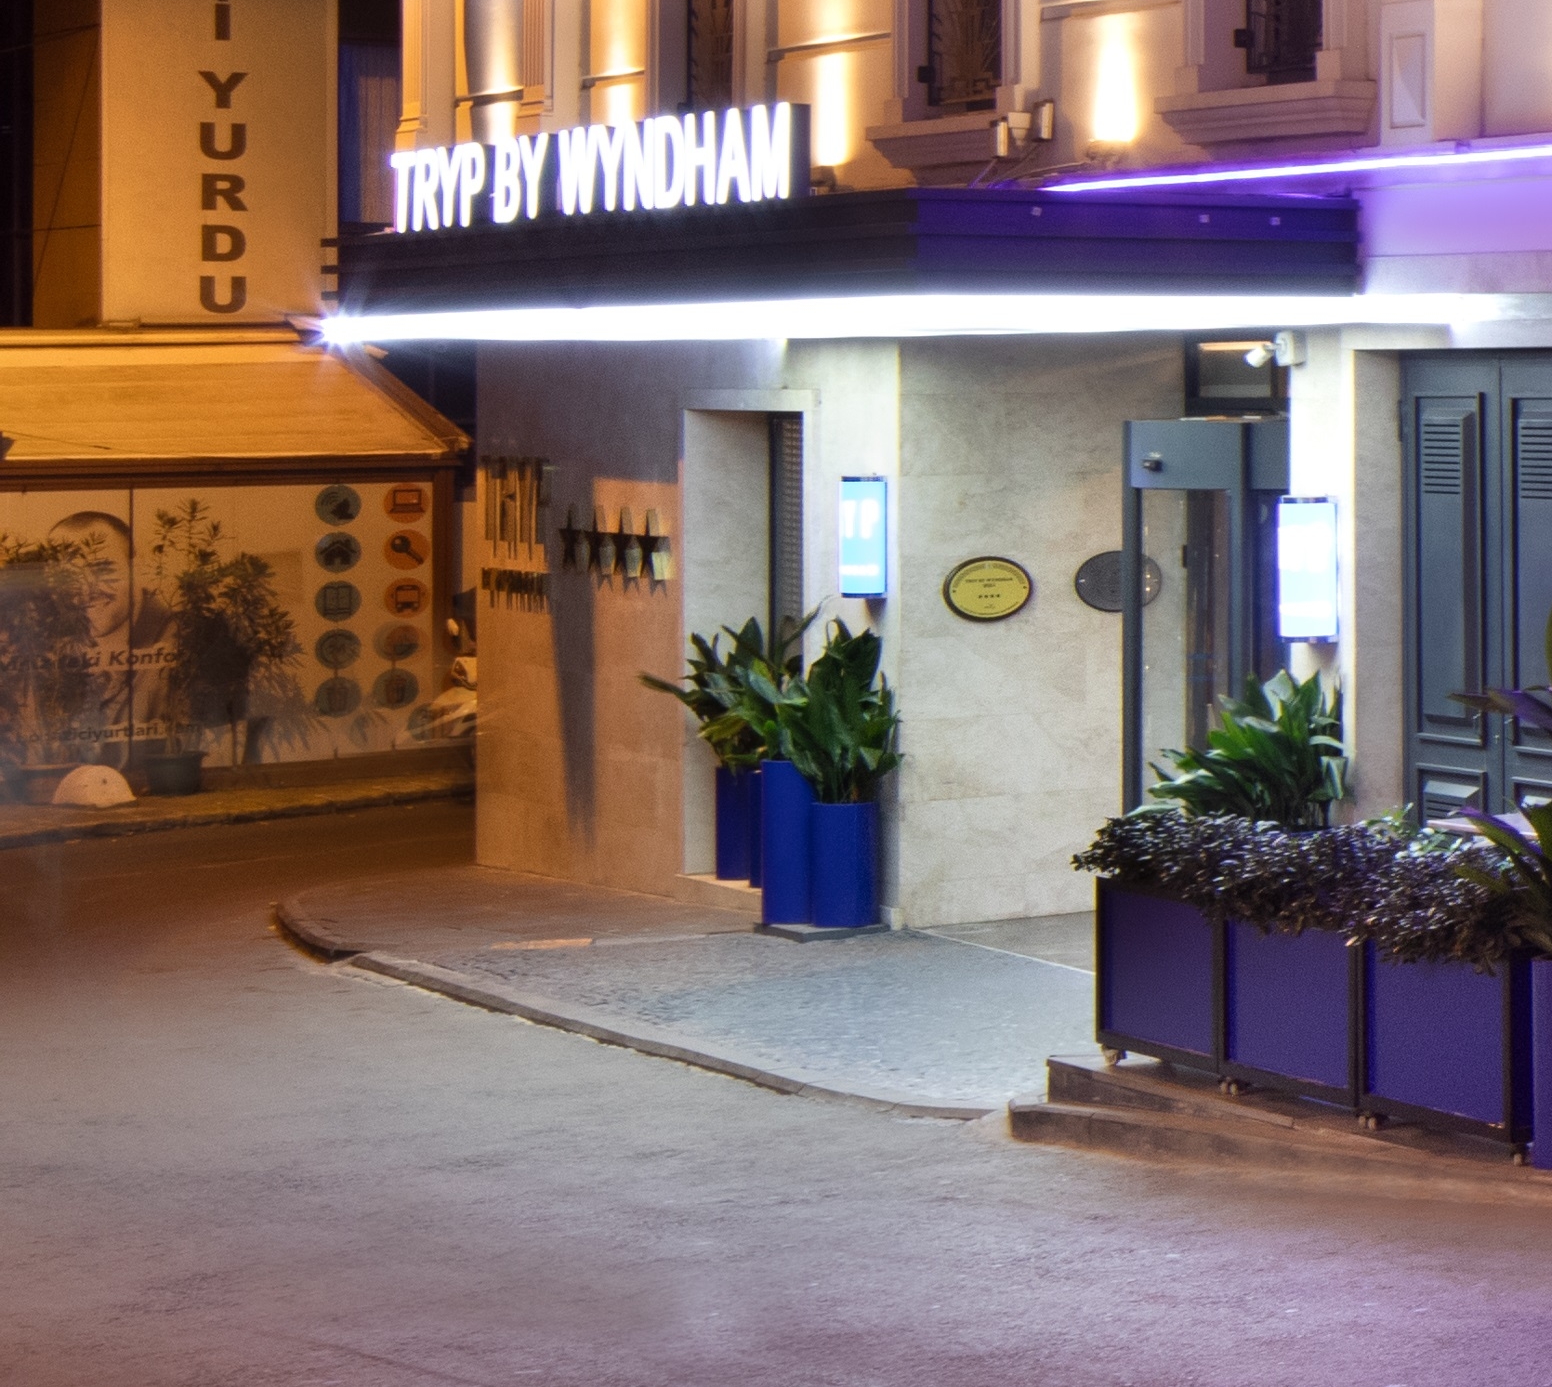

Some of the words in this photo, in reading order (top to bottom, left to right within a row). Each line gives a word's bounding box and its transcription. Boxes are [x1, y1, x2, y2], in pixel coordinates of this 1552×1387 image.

[198, 70, 249, 314] YURDU
[391, 141, 486, 234] TRYP
[492, 131, 549, 224] BY
[558, 100, 791, 216] WYNDHAM
[108, 646, 187, 668] Konfo
